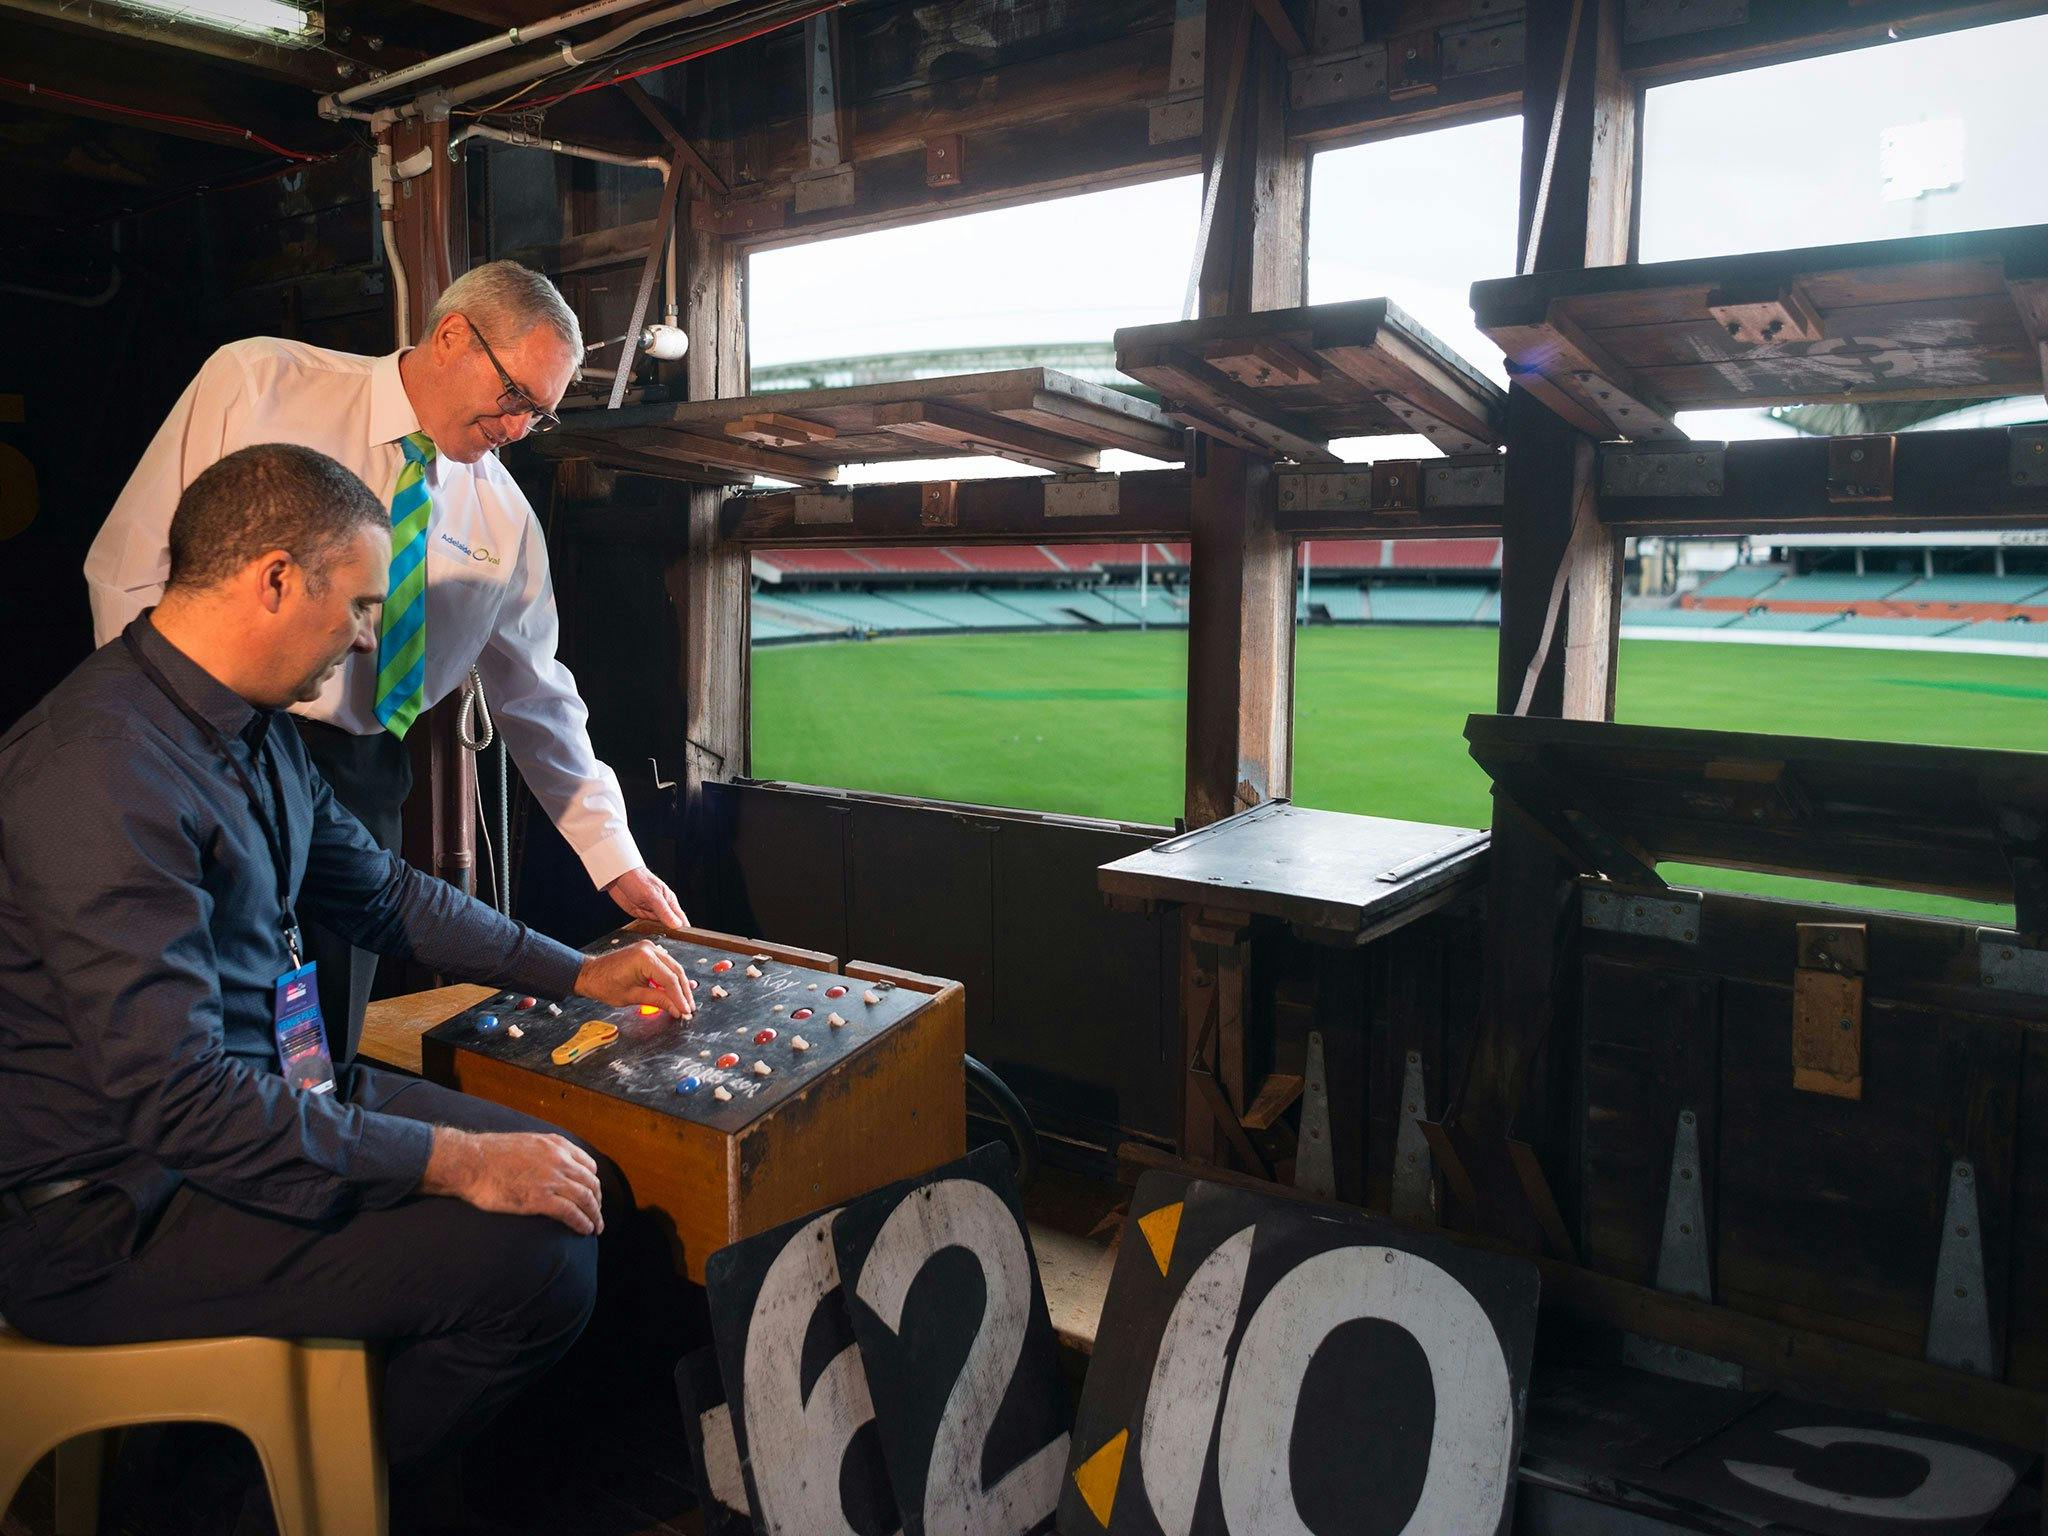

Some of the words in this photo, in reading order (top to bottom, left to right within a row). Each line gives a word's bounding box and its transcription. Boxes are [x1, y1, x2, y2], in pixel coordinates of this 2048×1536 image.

[441, 533, 472, 556] Adelaide
[473, 548, 501, 566] Oval
[855, 1178, 1071, 1536] 2
